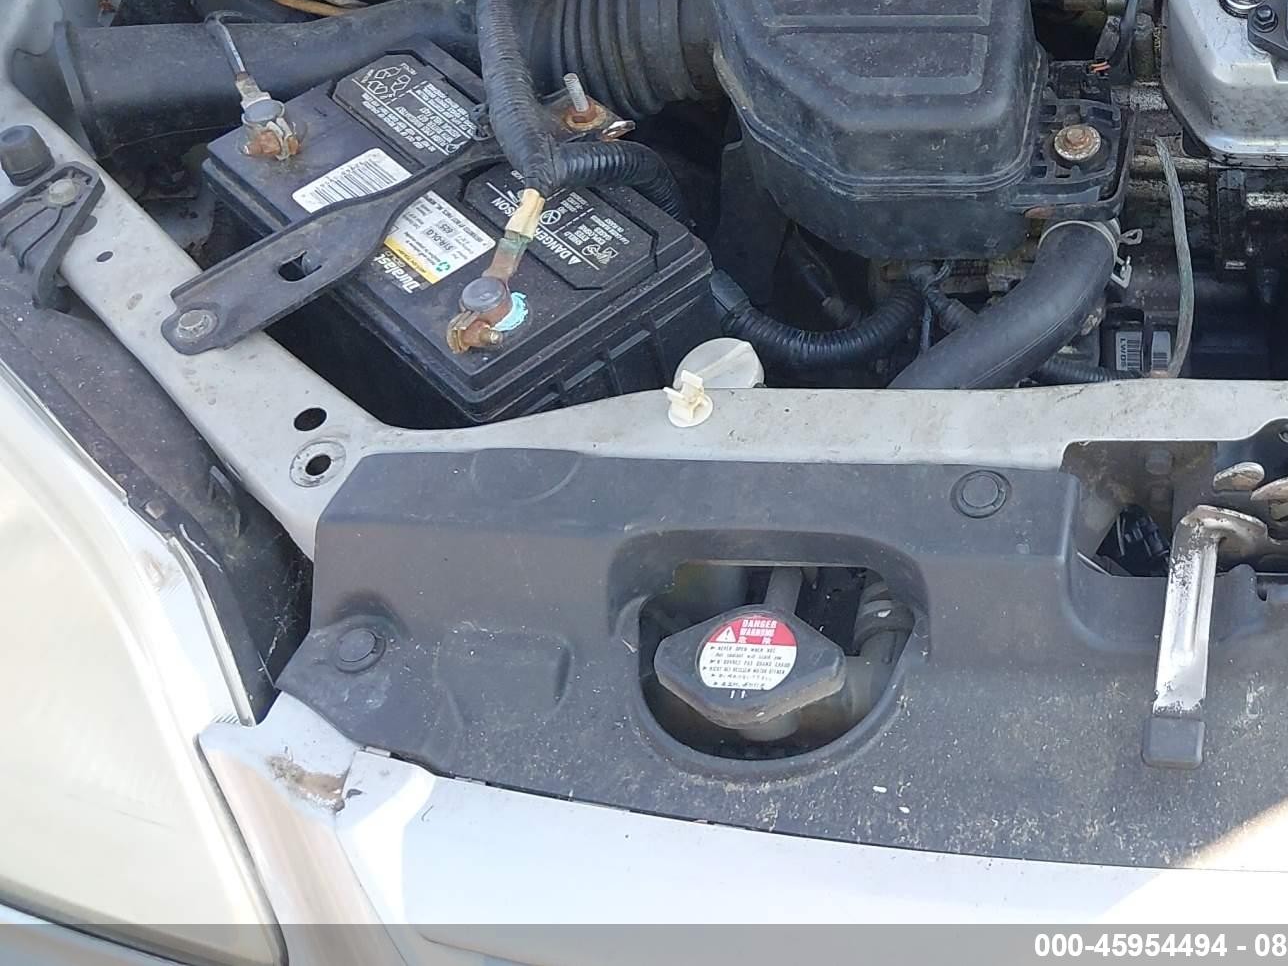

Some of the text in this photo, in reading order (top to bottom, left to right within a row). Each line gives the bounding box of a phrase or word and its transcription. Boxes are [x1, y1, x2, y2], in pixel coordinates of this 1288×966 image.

[534, 227, 573, 259] DANGER
[383, 249, 406, 268] GOLD
[371, 251, 422, 293] Duralast
[740, 628, 775, 637] WARNING
[742, 620, 777, 628] DANGER
